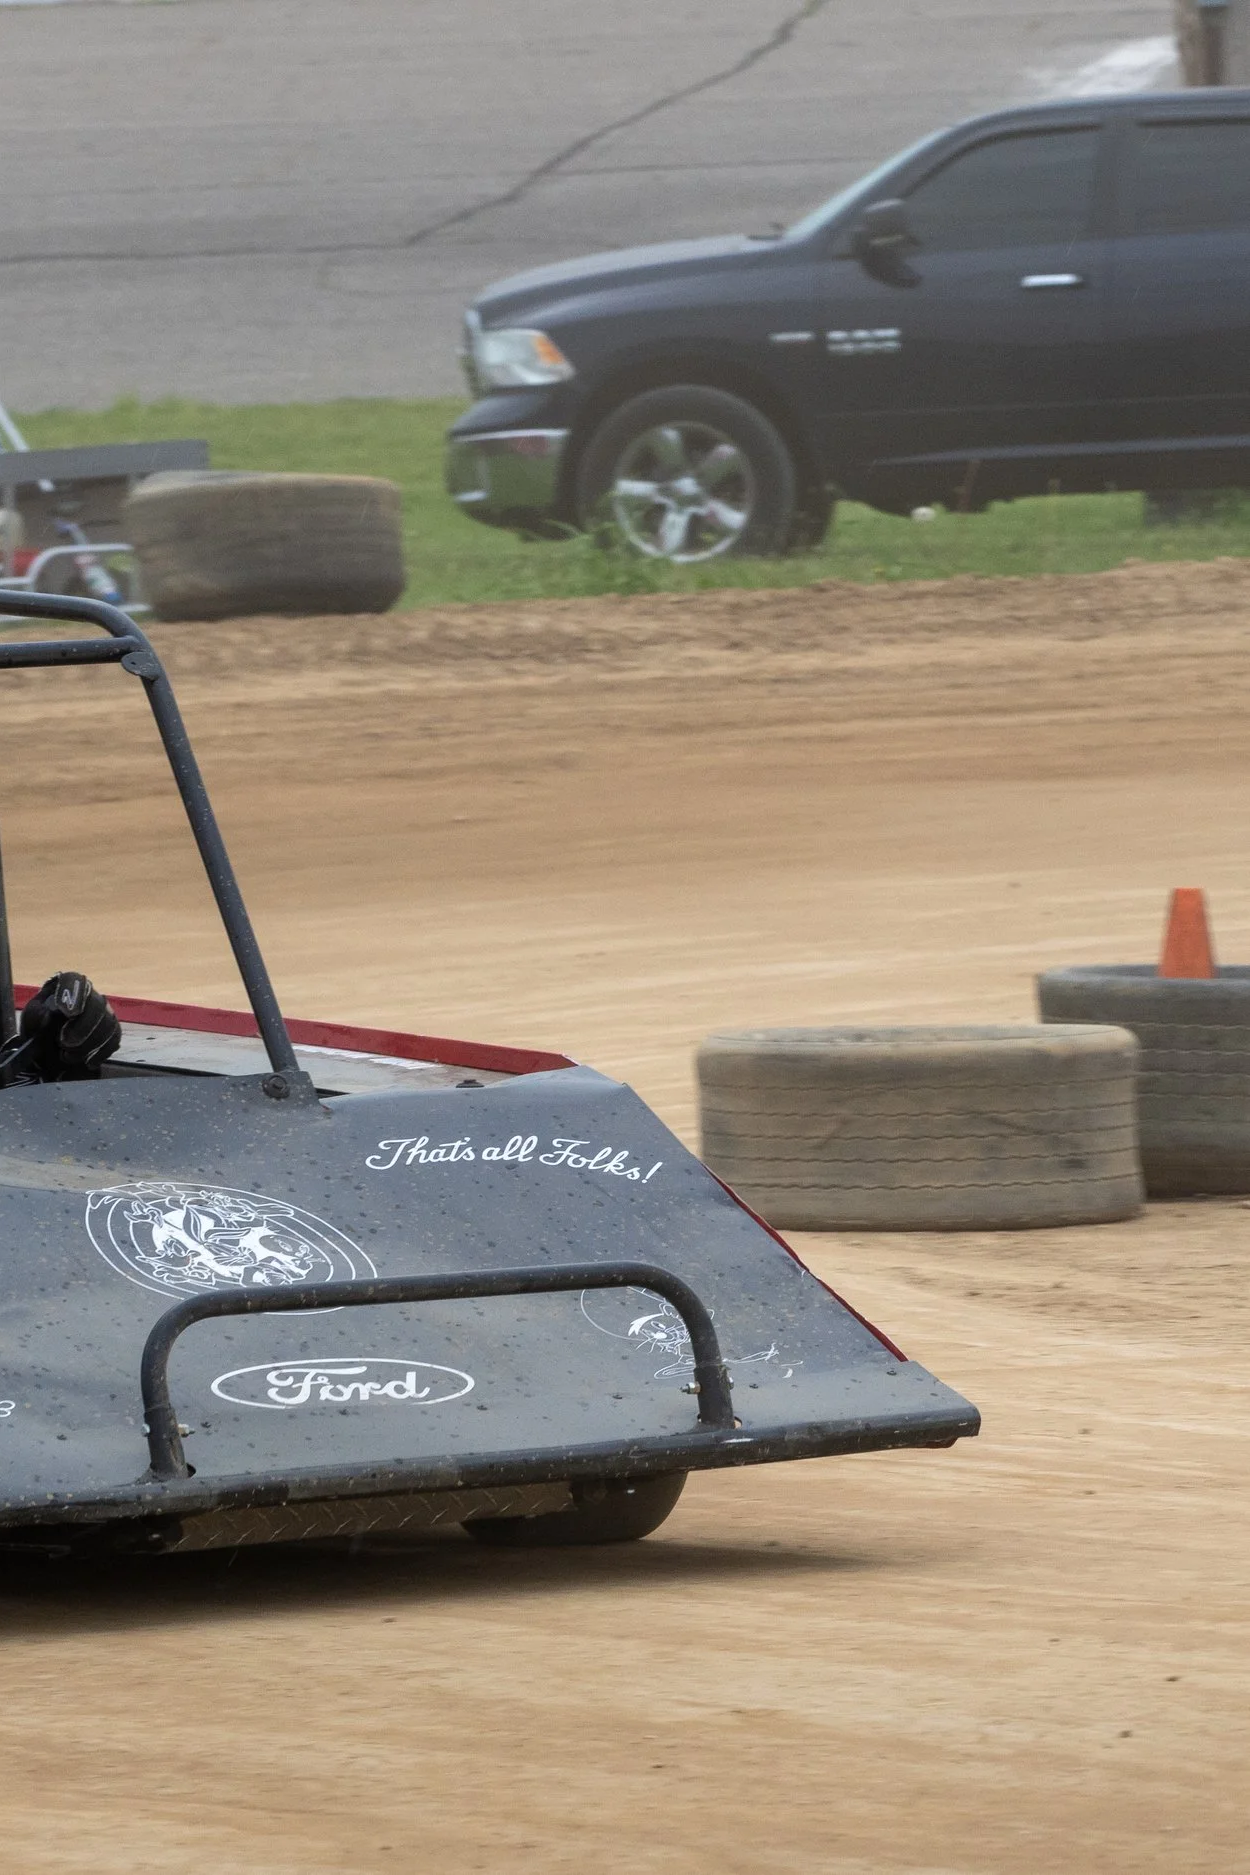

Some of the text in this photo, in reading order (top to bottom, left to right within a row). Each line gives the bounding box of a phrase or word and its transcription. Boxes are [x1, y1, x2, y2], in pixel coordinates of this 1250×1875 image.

[365, 1135, 663, 1184] That's all Folks!
[266, 1365, 431, 1404] Ford
